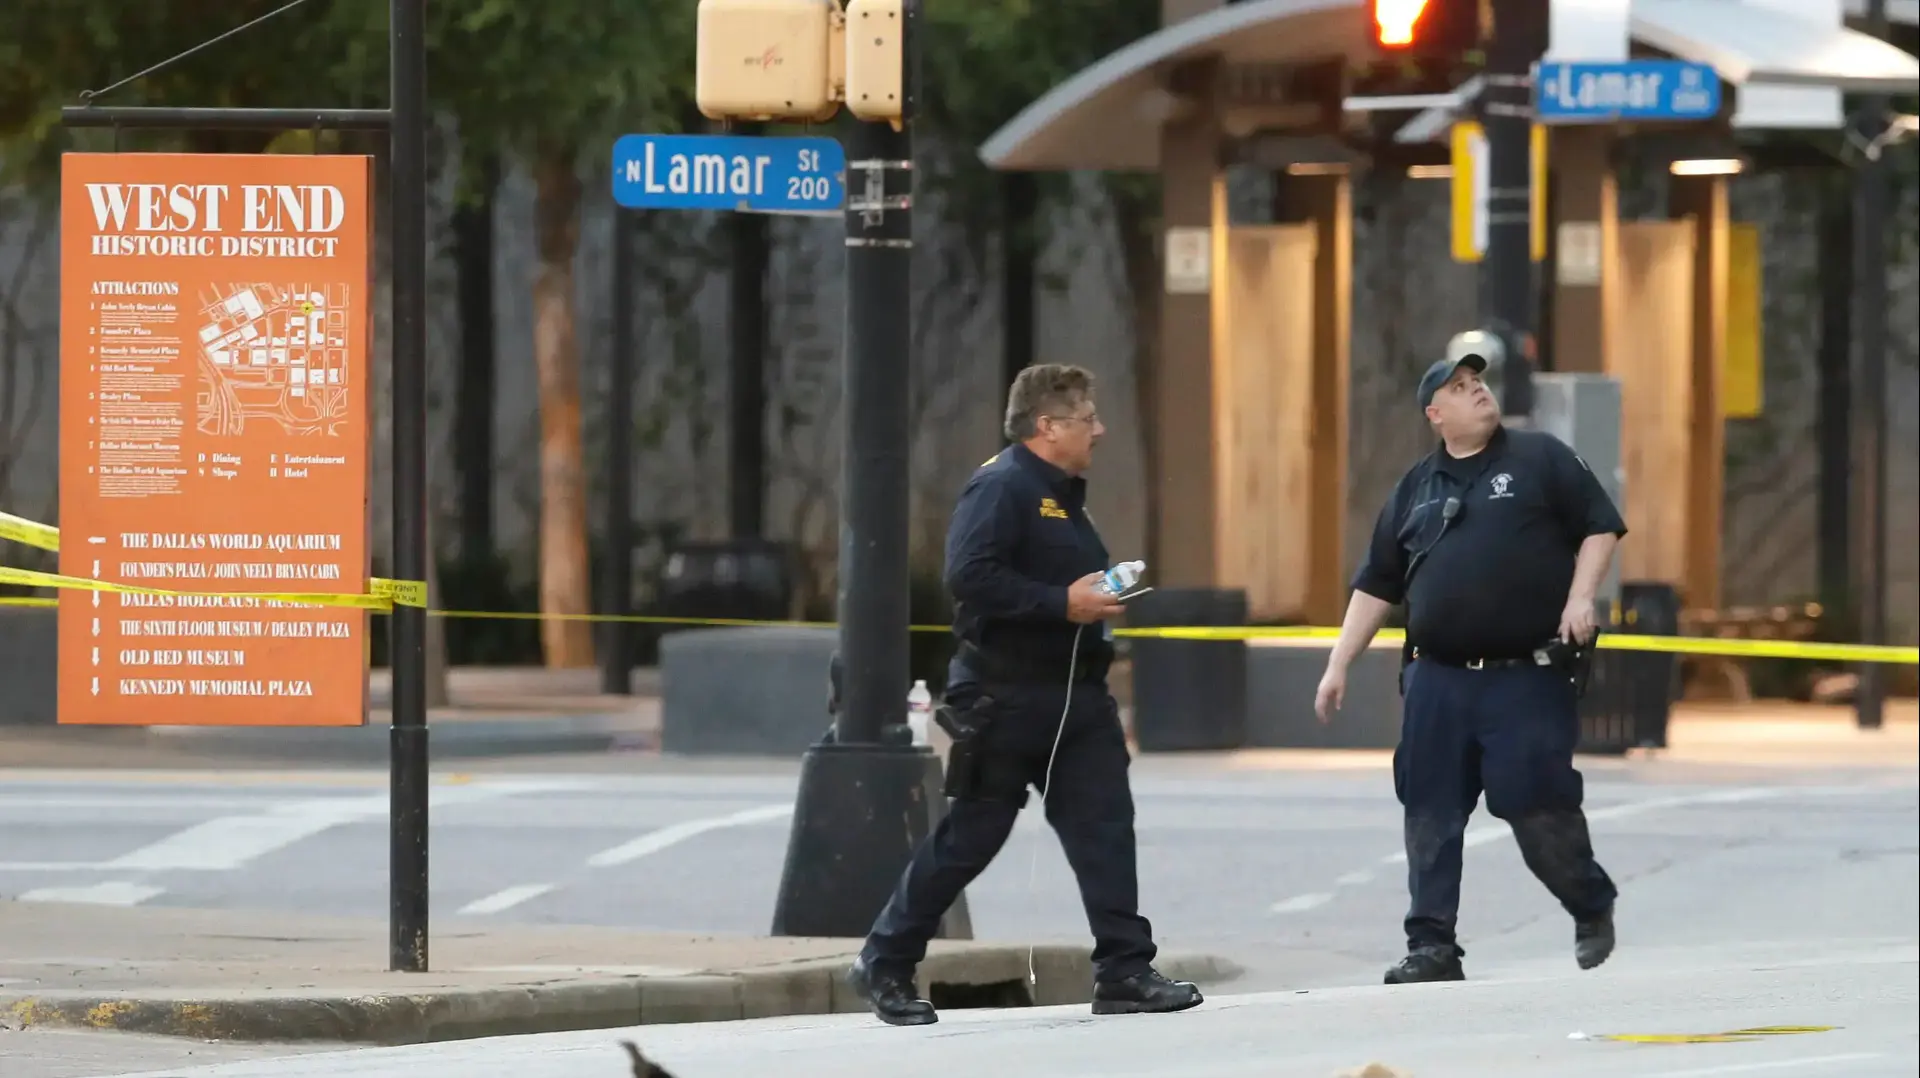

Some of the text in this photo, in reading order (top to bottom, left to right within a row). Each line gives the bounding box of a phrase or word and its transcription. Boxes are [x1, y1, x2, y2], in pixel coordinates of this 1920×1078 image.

[1559, 64, 1662, 109] Lamar
[626, 141, 771, 195] N Lamar
[798, 149, 820, 172] St
[787, 177, 830, 201] 200
[85, 183, 345, 233] WEST END
[91, 235, 338, 258] HISTORIC DISTRICT
[91, 281, 179, 296] ATTRACTIONS
[198, 453, 242, 465] D Dining
[284, 453, 345, 464] Entertainment
[212, 468, 238, 480] Shops
[284, 468, 308, 478] Hotel
[120, 533, 341, 553] THE DALLAS WORLD AQUARIUM
[120, 562, 174, 578] FOUNDER'S
[176, 563, 206, 578] PLAZA
[214, 563, 242, 579] JOHN
[243, 563, 274, 579] NEELY
[275, 564, 309, 579] BRYAN
[310, 564, 340, 580] CABIN
[120, 591, 174, 607] DALLAS
[120, 620, 142, 636] THE
[143, 620, 177, 636] SIXTH
[178, 621, 216, 636] FLOOR
[217, 621, 263, 637] MUSEUM
[271, 622, 314, 637] DEALEY
[316, 622, 350, 638] PLAZA
[120, 649, 245, 666] OLD RED MUSEUM
[120, 679, 313, 697] KENNEDY MEMORIAL PLAZA
